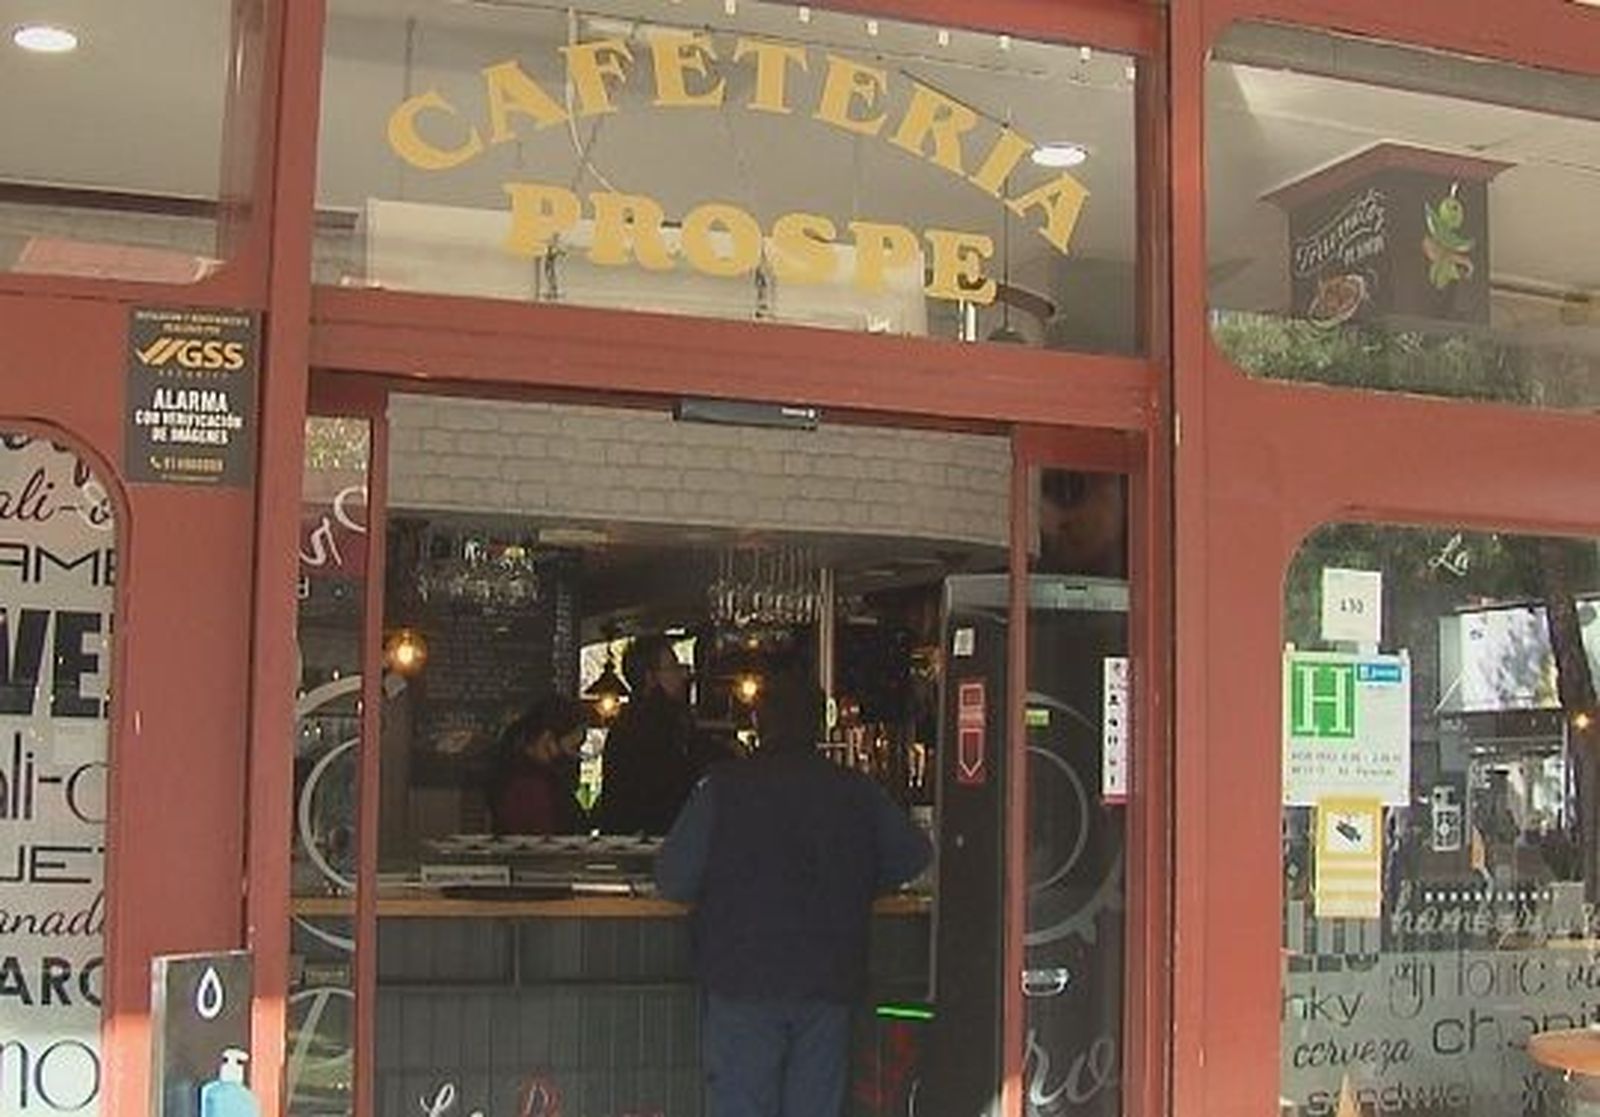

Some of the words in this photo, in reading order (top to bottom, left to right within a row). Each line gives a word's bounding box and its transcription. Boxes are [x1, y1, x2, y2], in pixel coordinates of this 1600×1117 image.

[387, 34, 1093, 254] CAFETERIA
[502, 180, 997, 306] PROSPE
[176, 339, 244, 370] GSS
[153, 387, 229, 413] ALARMA
[1293, 1036, 1416, 1077] cerveza
